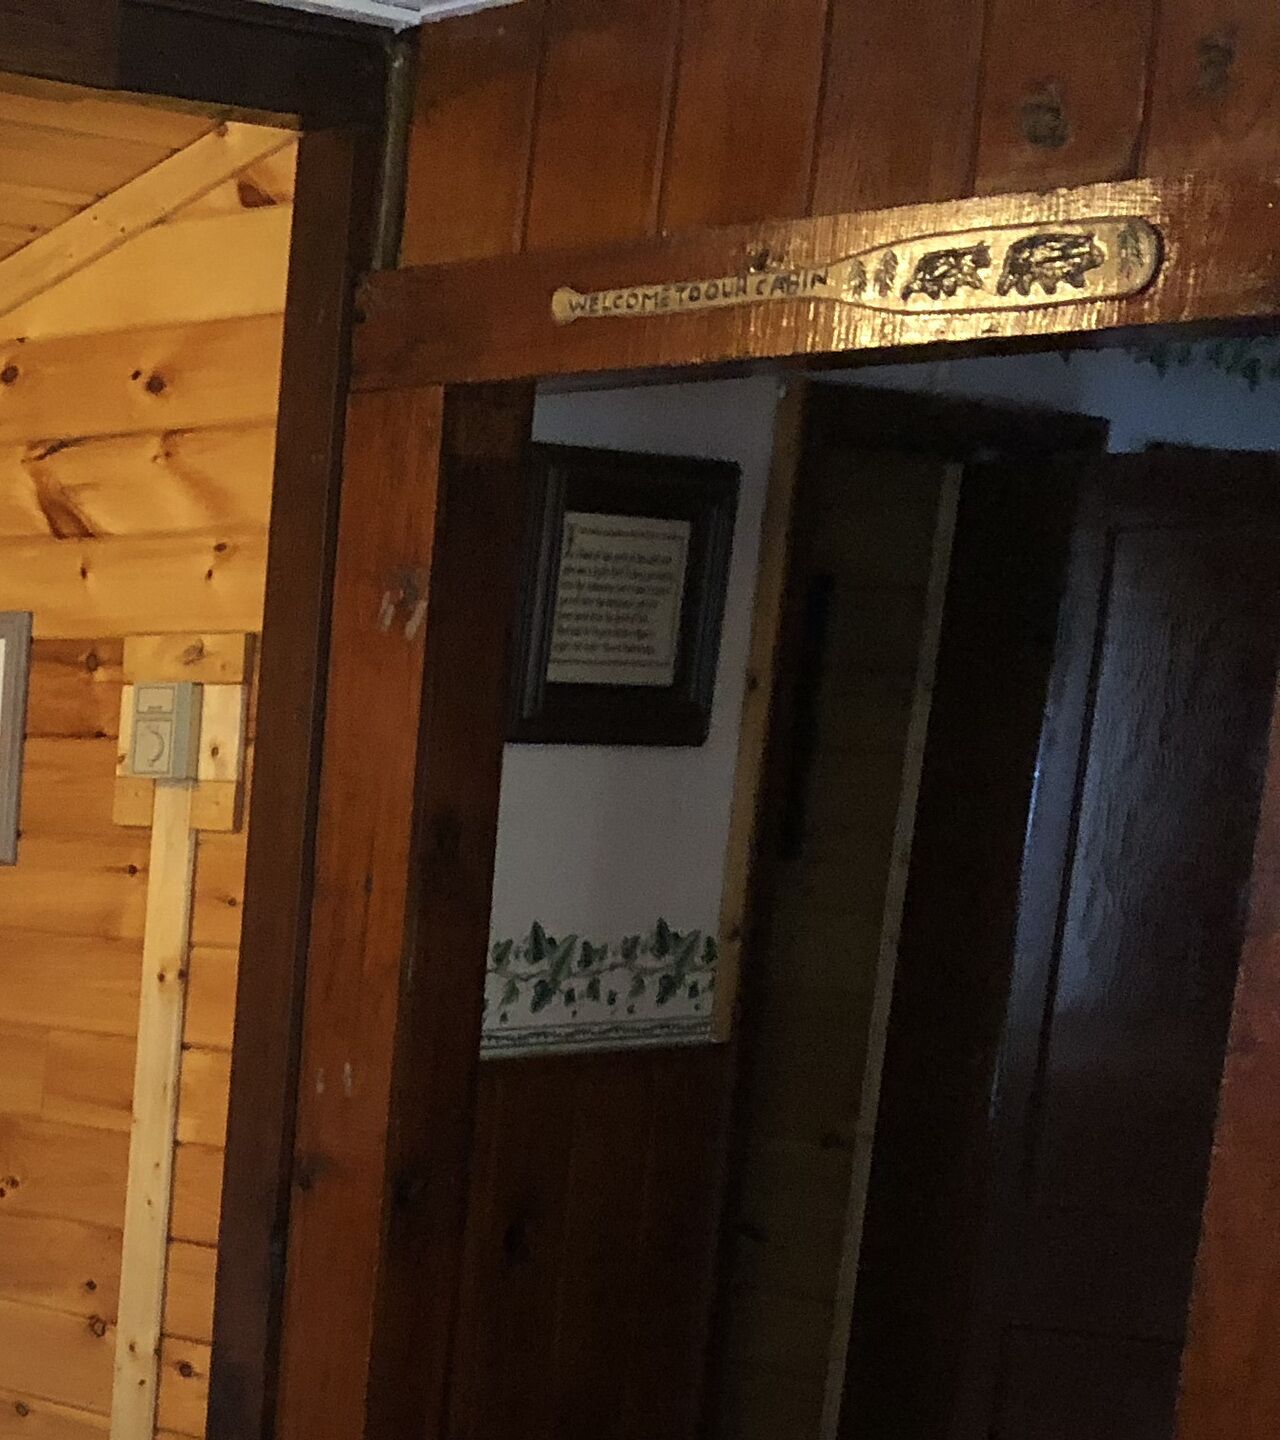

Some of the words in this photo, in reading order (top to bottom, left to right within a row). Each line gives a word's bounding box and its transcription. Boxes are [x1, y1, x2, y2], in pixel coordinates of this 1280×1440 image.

[568, 287, 669, 315] WELCOME
[675, 284, 701, 303] TO
[754, 268, 830, 297] CABIN
